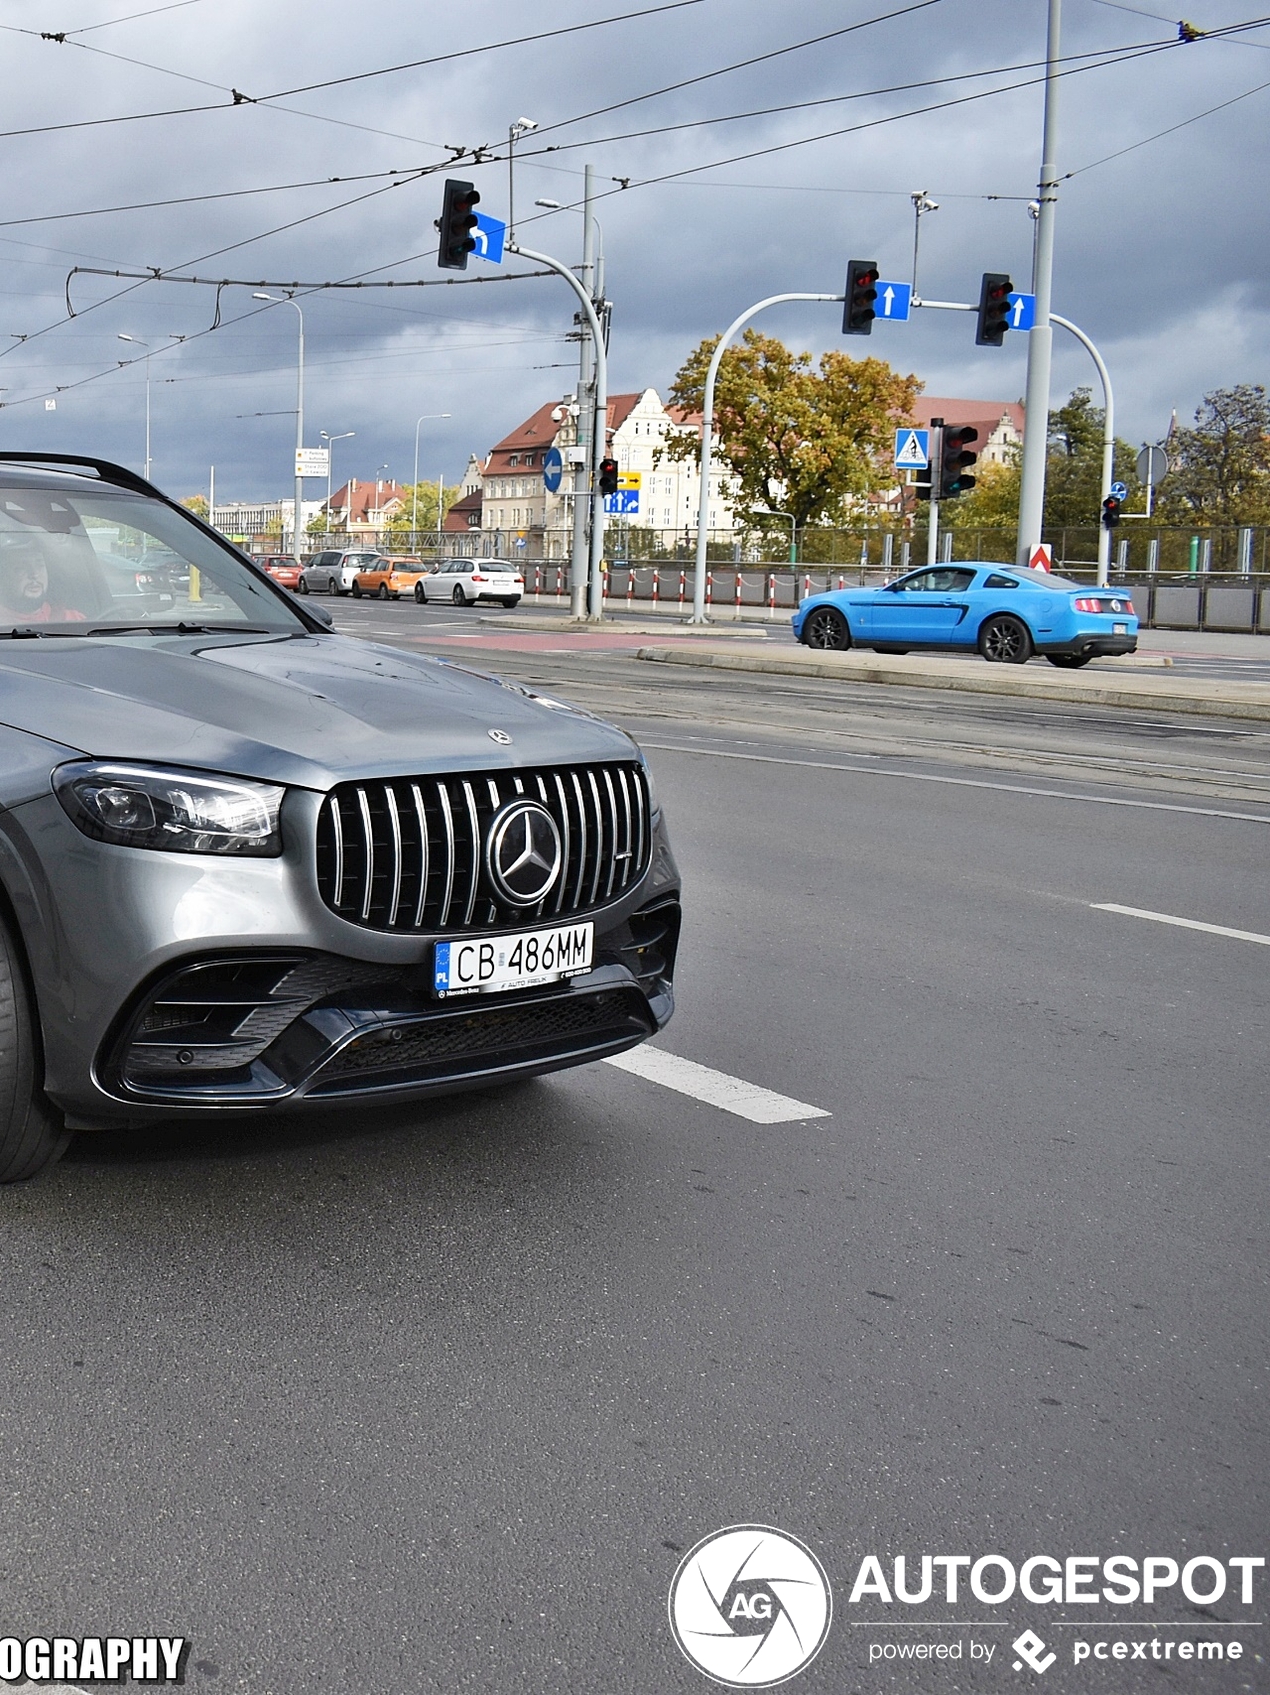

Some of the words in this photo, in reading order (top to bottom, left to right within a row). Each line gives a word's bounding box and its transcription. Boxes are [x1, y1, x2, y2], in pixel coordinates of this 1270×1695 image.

[457, 943, 495, 983] CB
[508, 928, 587, 975] 486MM
[436, 972, 448, 983] PL
[508, 979, 526, 989] AUTO
